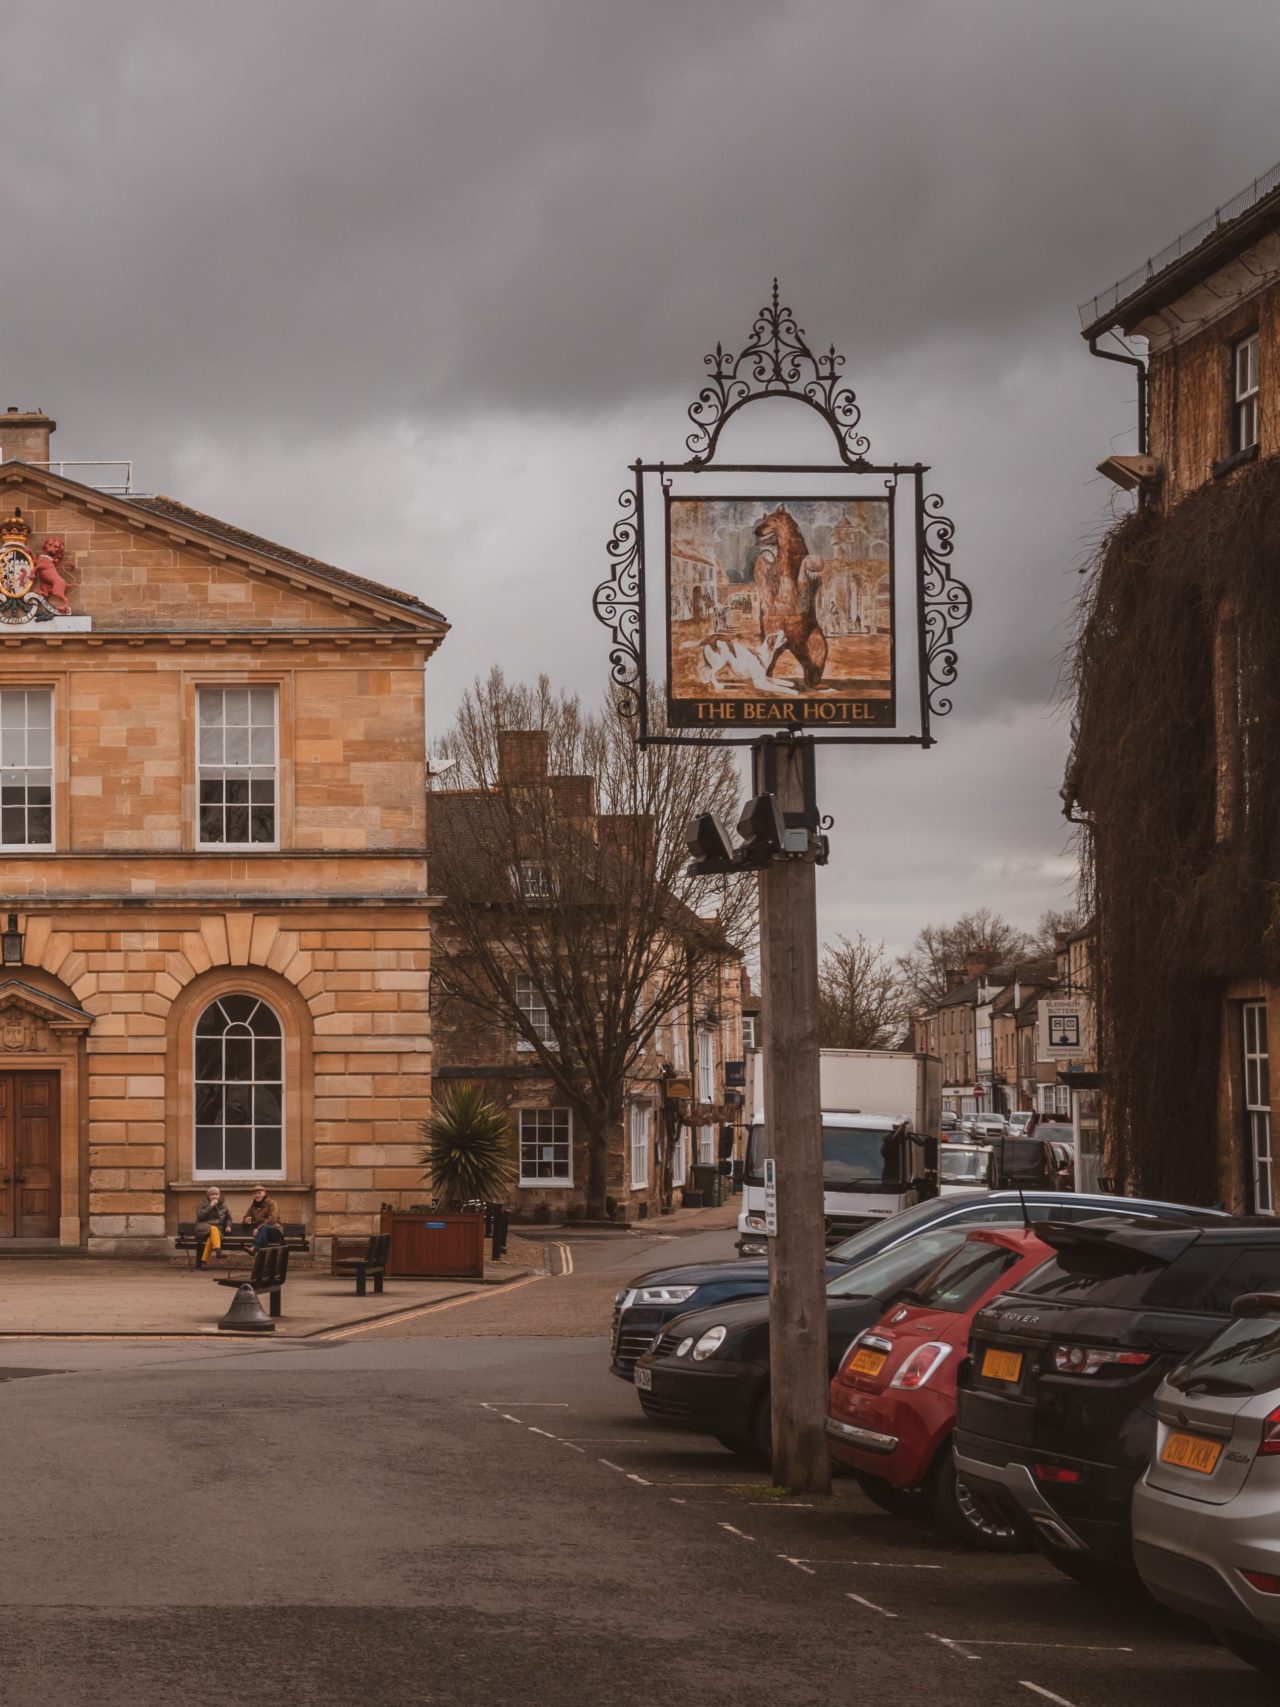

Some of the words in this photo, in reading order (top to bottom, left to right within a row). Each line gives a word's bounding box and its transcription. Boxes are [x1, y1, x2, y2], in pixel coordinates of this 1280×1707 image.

[693, 702, 736, 720] THE
[743, 702, 797, 720] BEAR
[803, 702, 875, 720] HOTEL
[1002, 1312, 1040, 1325] ROVER
